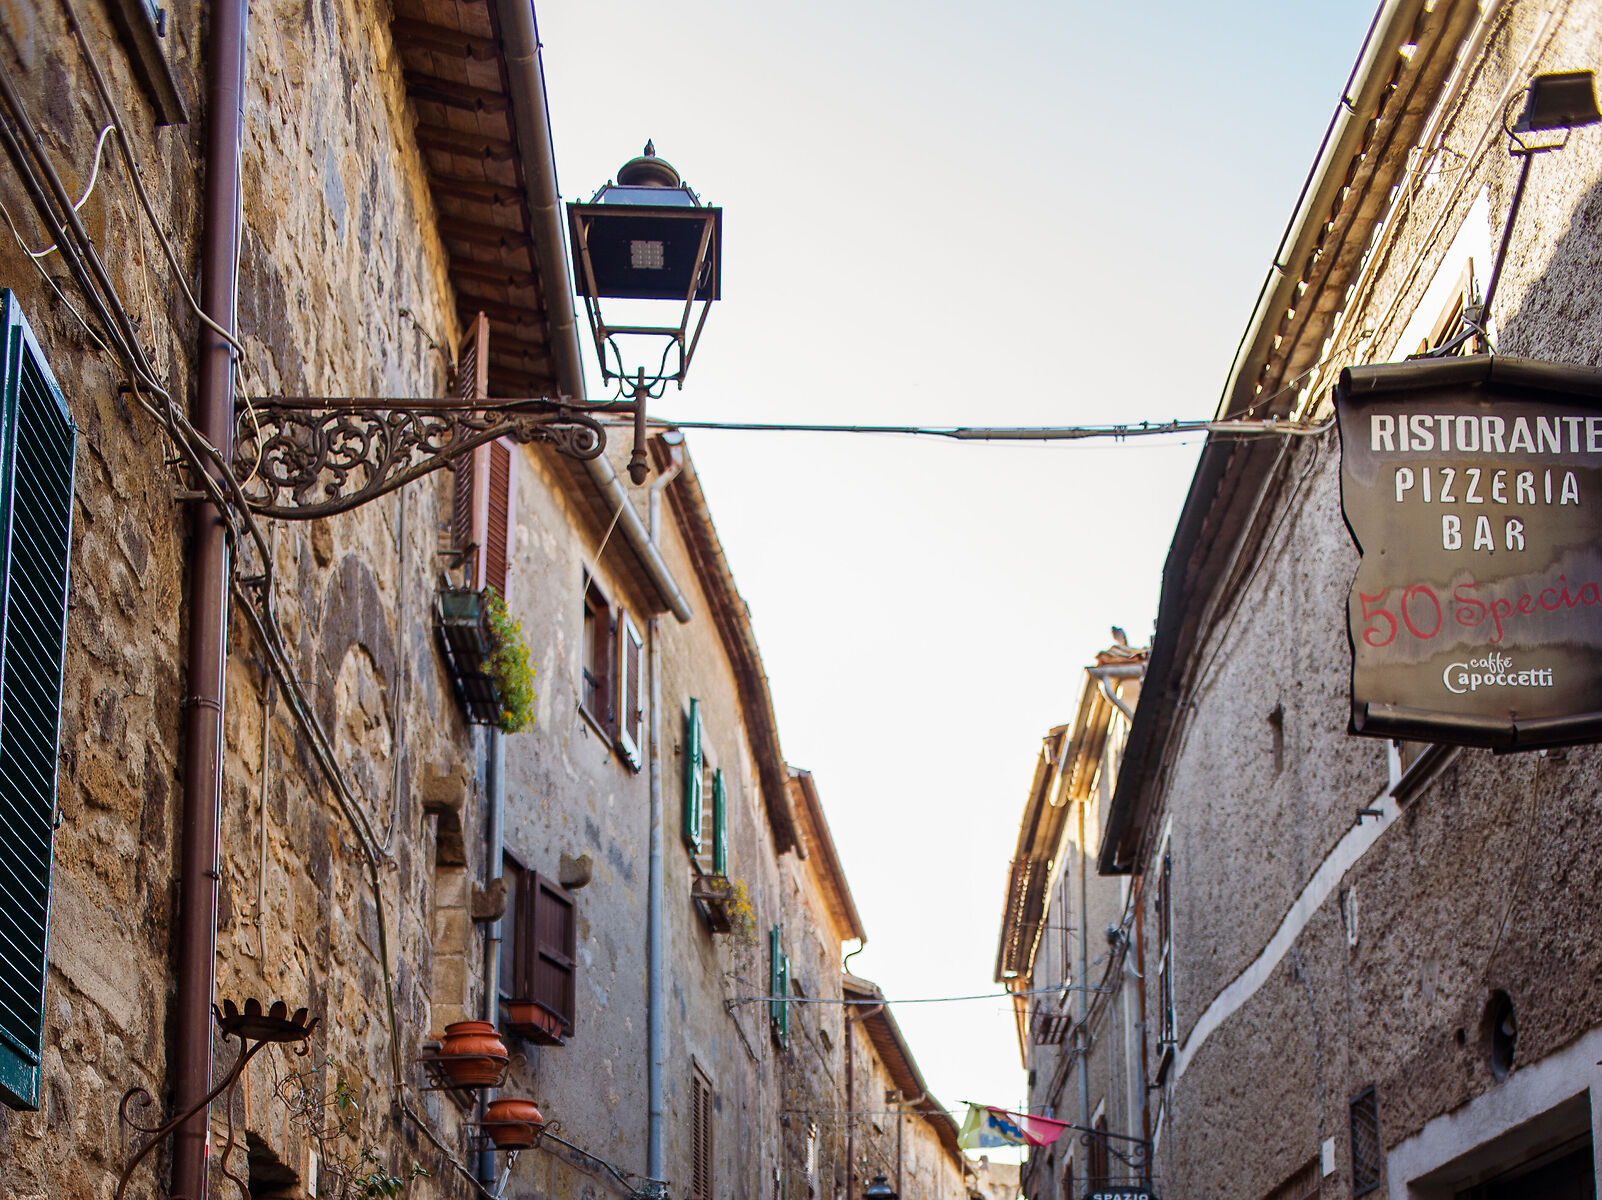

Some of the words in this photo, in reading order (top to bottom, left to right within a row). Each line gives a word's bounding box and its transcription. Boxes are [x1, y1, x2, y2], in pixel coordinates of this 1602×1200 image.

[1370, 414, 1602, 454] RISTORANTE
[1395, 467, 1579, 505] PIZZERIA
[1441, 514, 1525, 551] BAR
[1358, 583, 1442, 647] 50
[1453, 574, 1602, 643] Specia
[1443, 663, 1553, 694] Capoccetti
